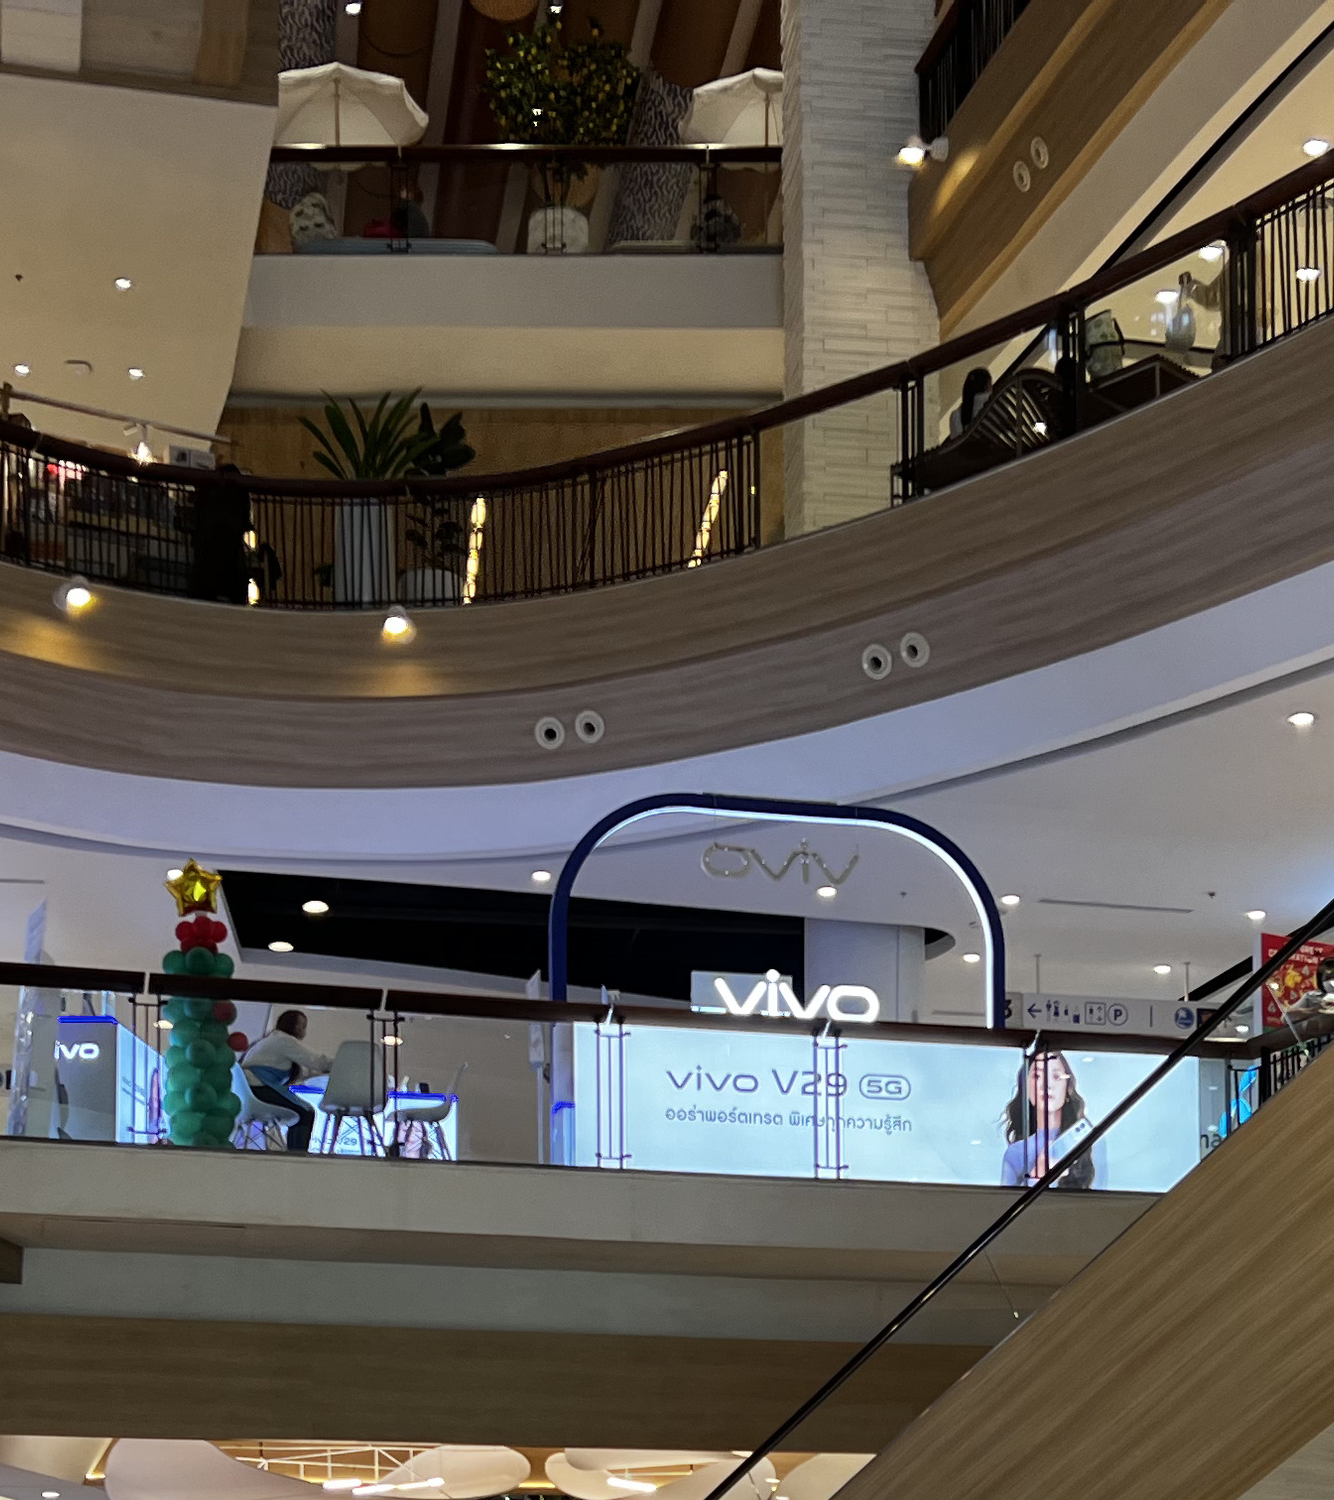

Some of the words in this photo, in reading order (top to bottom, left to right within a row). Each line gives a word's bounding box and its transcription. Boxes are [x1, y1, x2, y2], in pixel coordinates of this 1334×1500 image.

[714, 968, 881, 1024] vivo
[666, 1065, 759, 1093] vivo
[771, 1069, 848, 1097] V29
[867, 1079, 903, 1095] 5G
